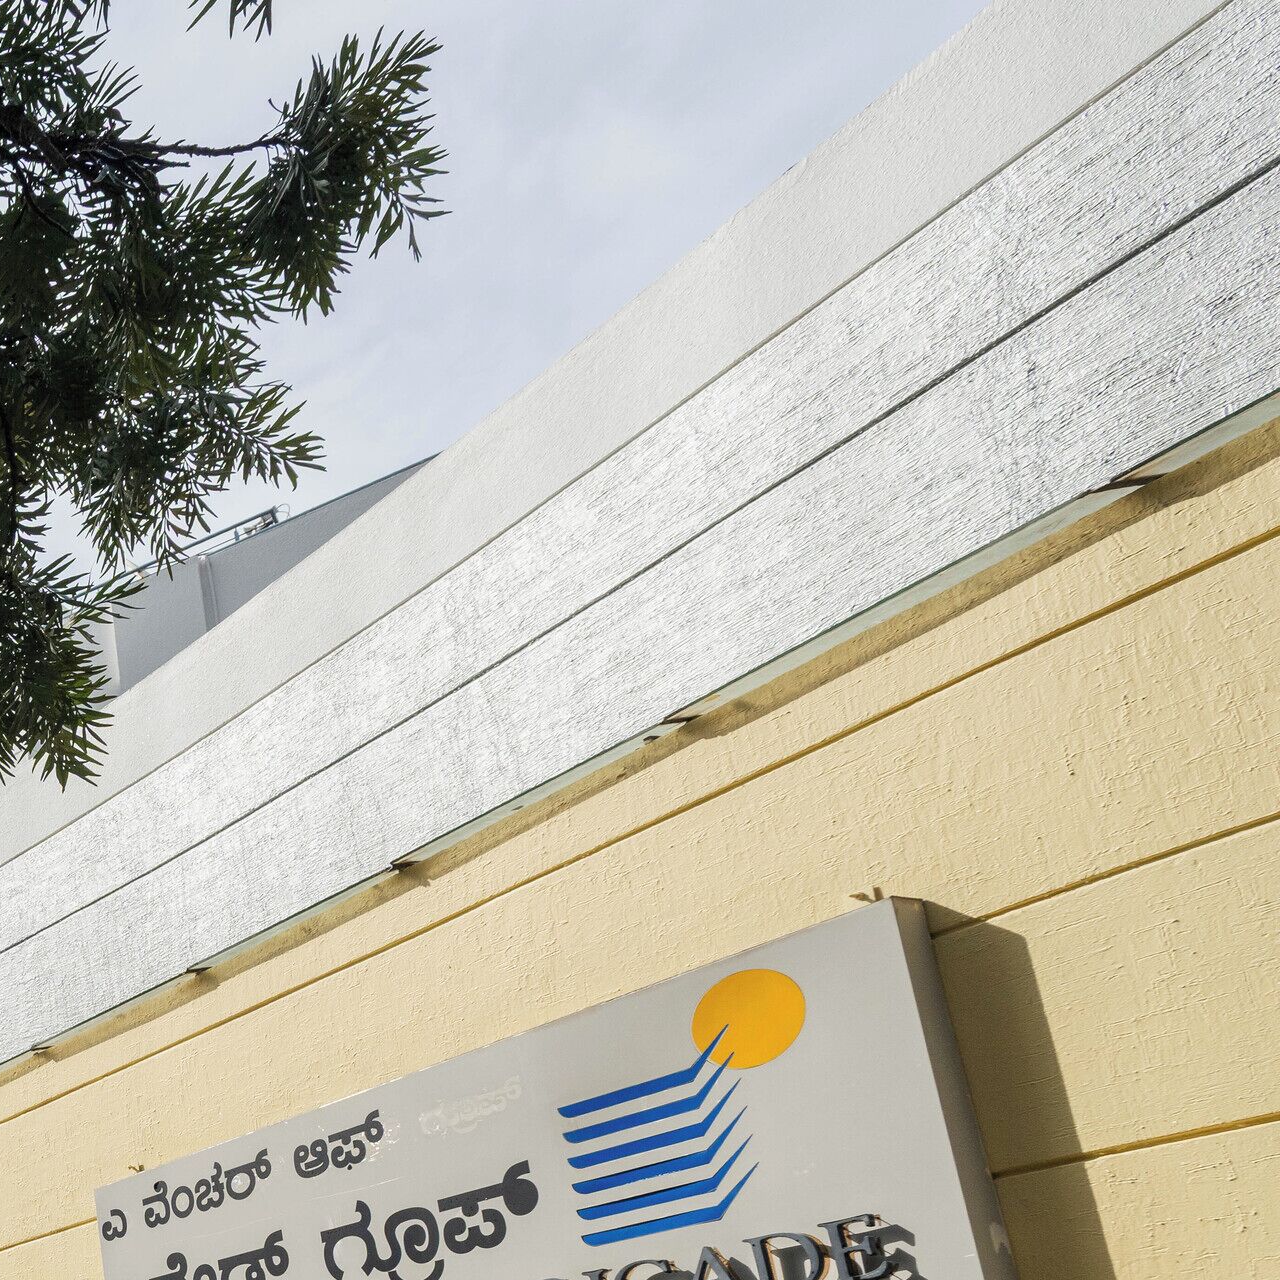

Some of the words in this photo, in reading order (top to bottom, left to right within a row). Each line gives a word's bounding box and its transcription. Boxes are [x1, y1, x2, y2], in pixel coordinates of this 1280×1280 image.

[102, 1208, 127, 1241] ಎ
[142, 1148, 272, 1229] ವೆಂಚರ್
[294, 1110, 384, 1178] ಆಫ್
